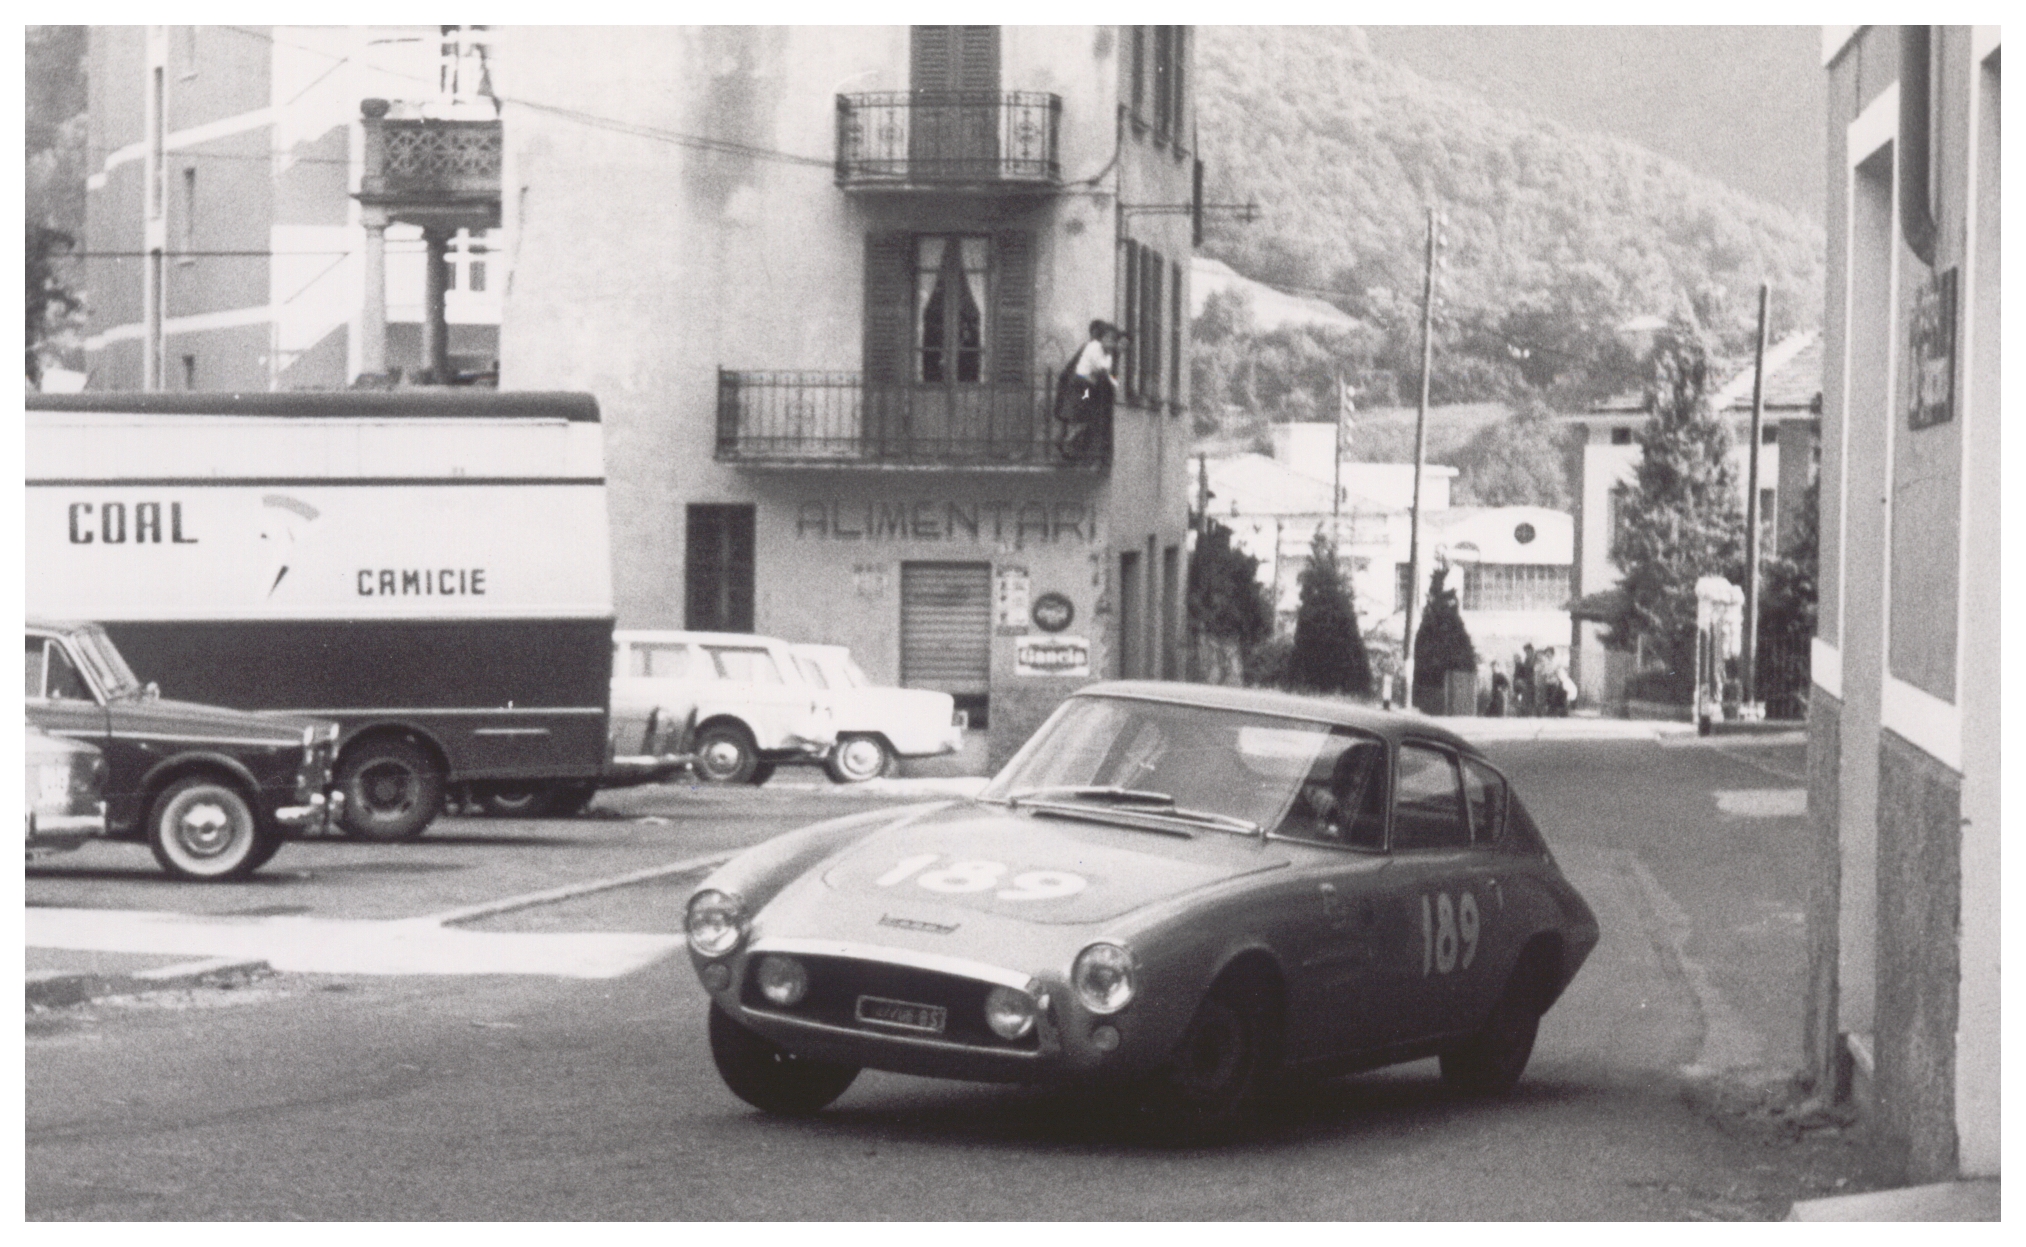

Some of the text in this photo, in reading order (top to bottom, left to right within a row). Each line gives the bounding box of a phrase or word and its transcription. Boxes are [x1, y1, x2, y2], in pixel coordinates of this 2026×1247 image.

[68, 502, 198, 544] COAL
[797, 501, 1096, 543] ALIMENTARI
[357, 569, 487, 596] CAMICIE
[1019, 647, 1086, 666] Gancia
[876, 854, 1087, 900] 189
[1422, 892, 1480, 979] 189
